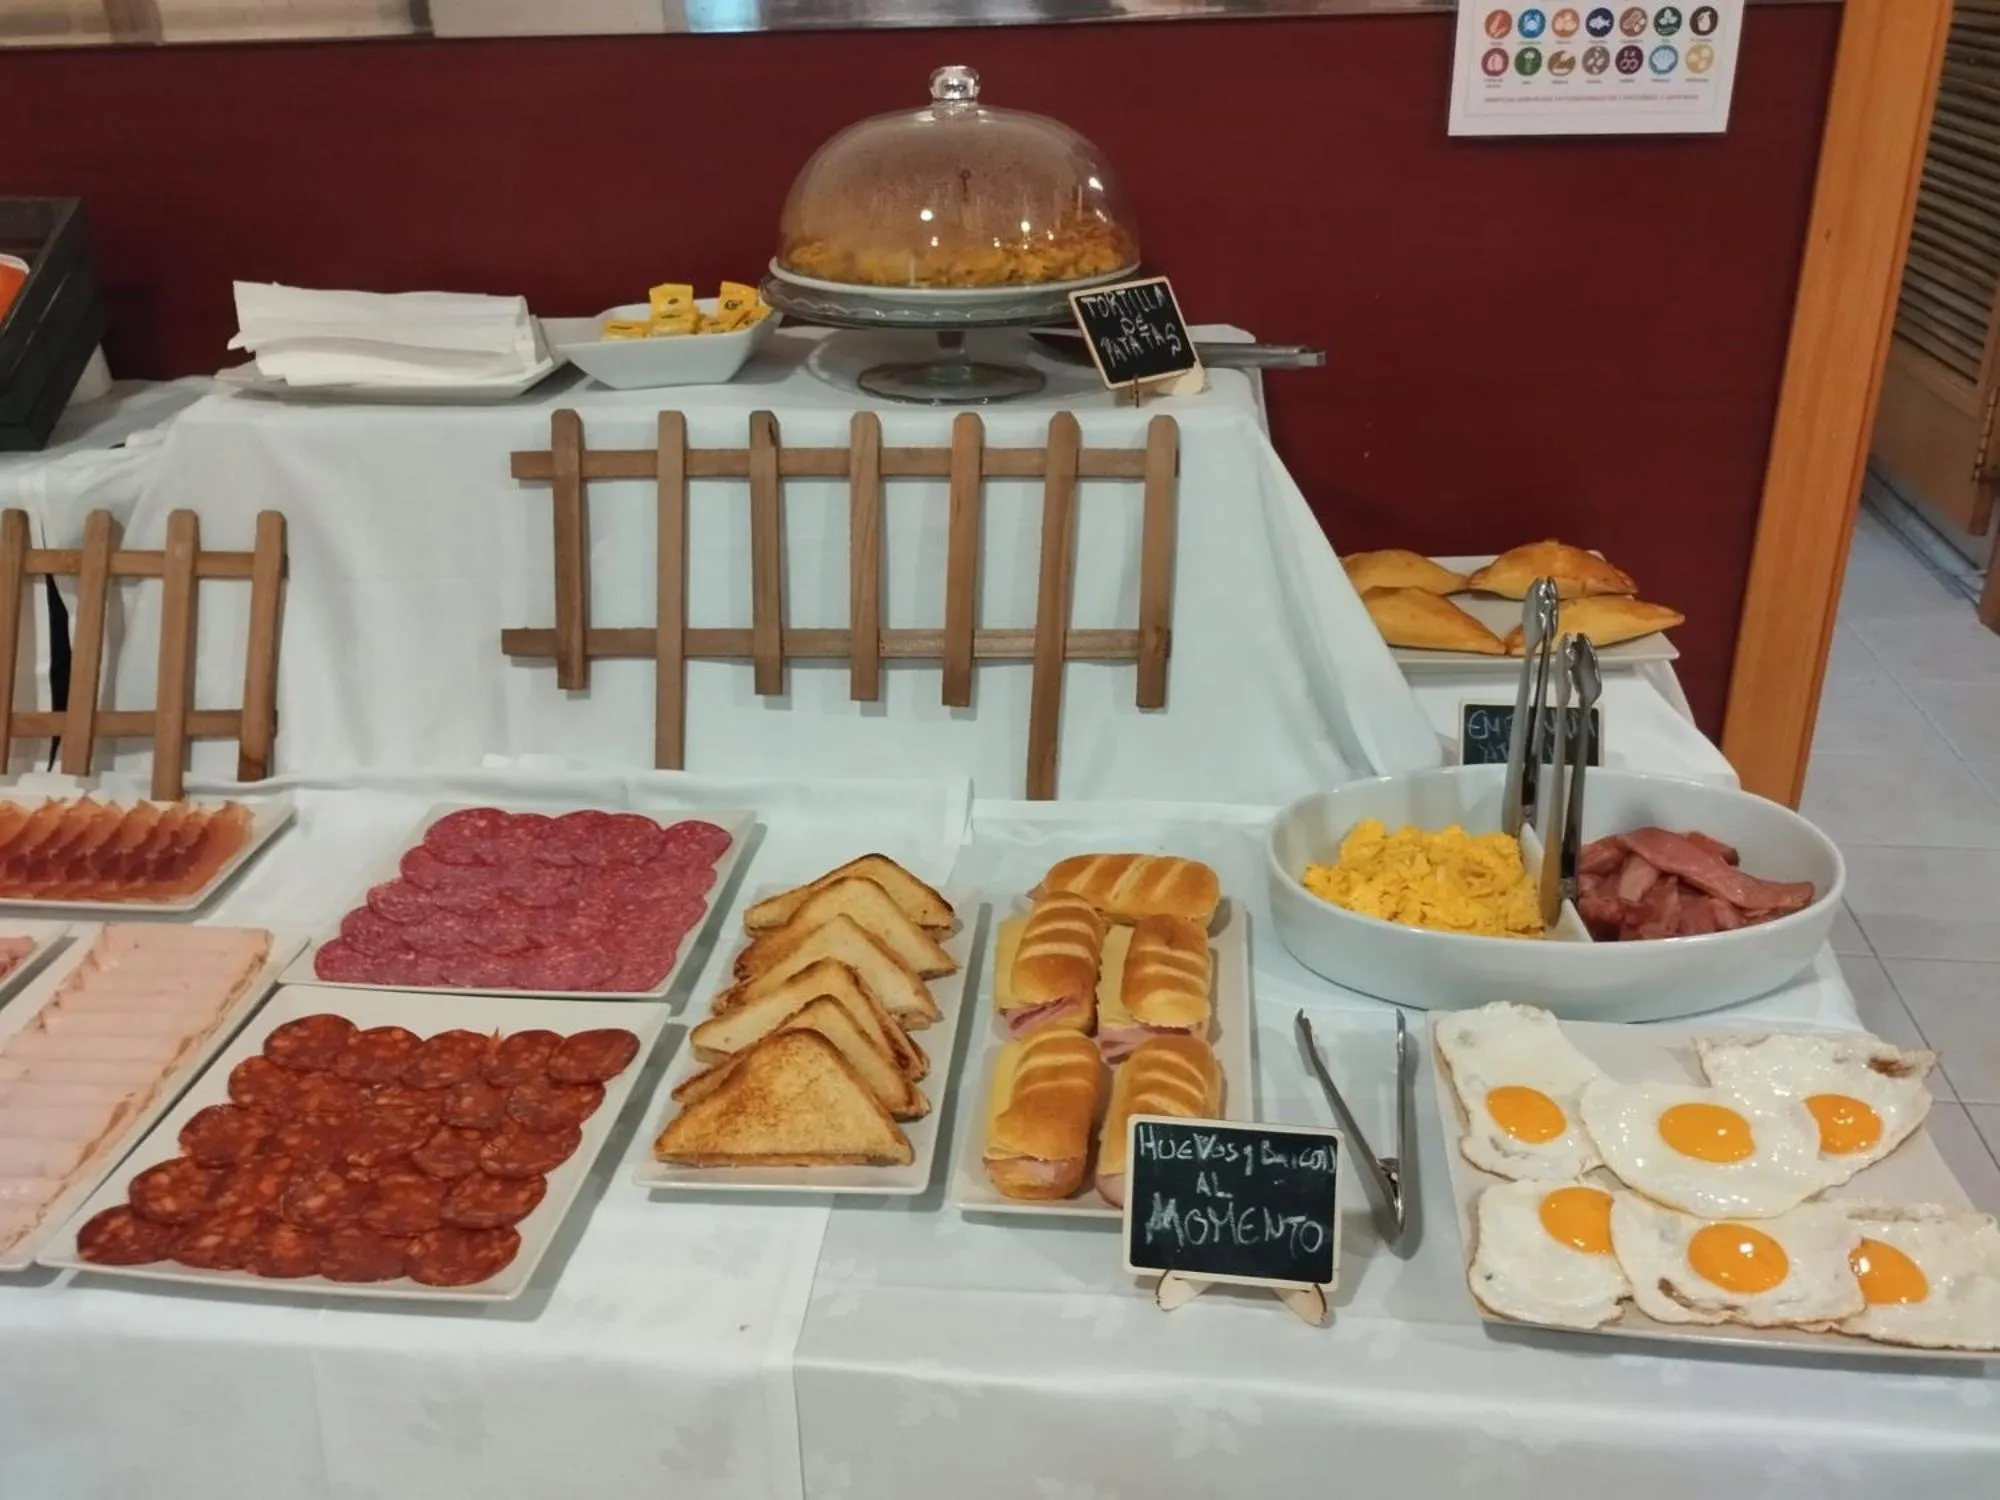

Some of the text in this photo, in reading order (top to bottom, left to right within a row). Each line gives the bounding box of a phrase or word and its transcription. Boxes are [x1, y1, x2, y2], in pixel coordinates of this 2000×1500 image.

[1080, 284, 1165, 318] TORTILLA
[1120, 314, 1148, 337] DE
[1100, 323, 1182, 369] PATATAS
[1138, 1124, 1240, 1163] HUEVOS
[1196, 1171, 1234, 1199] AL
[1145, 1191, 1323, 1258] MOMENTO
